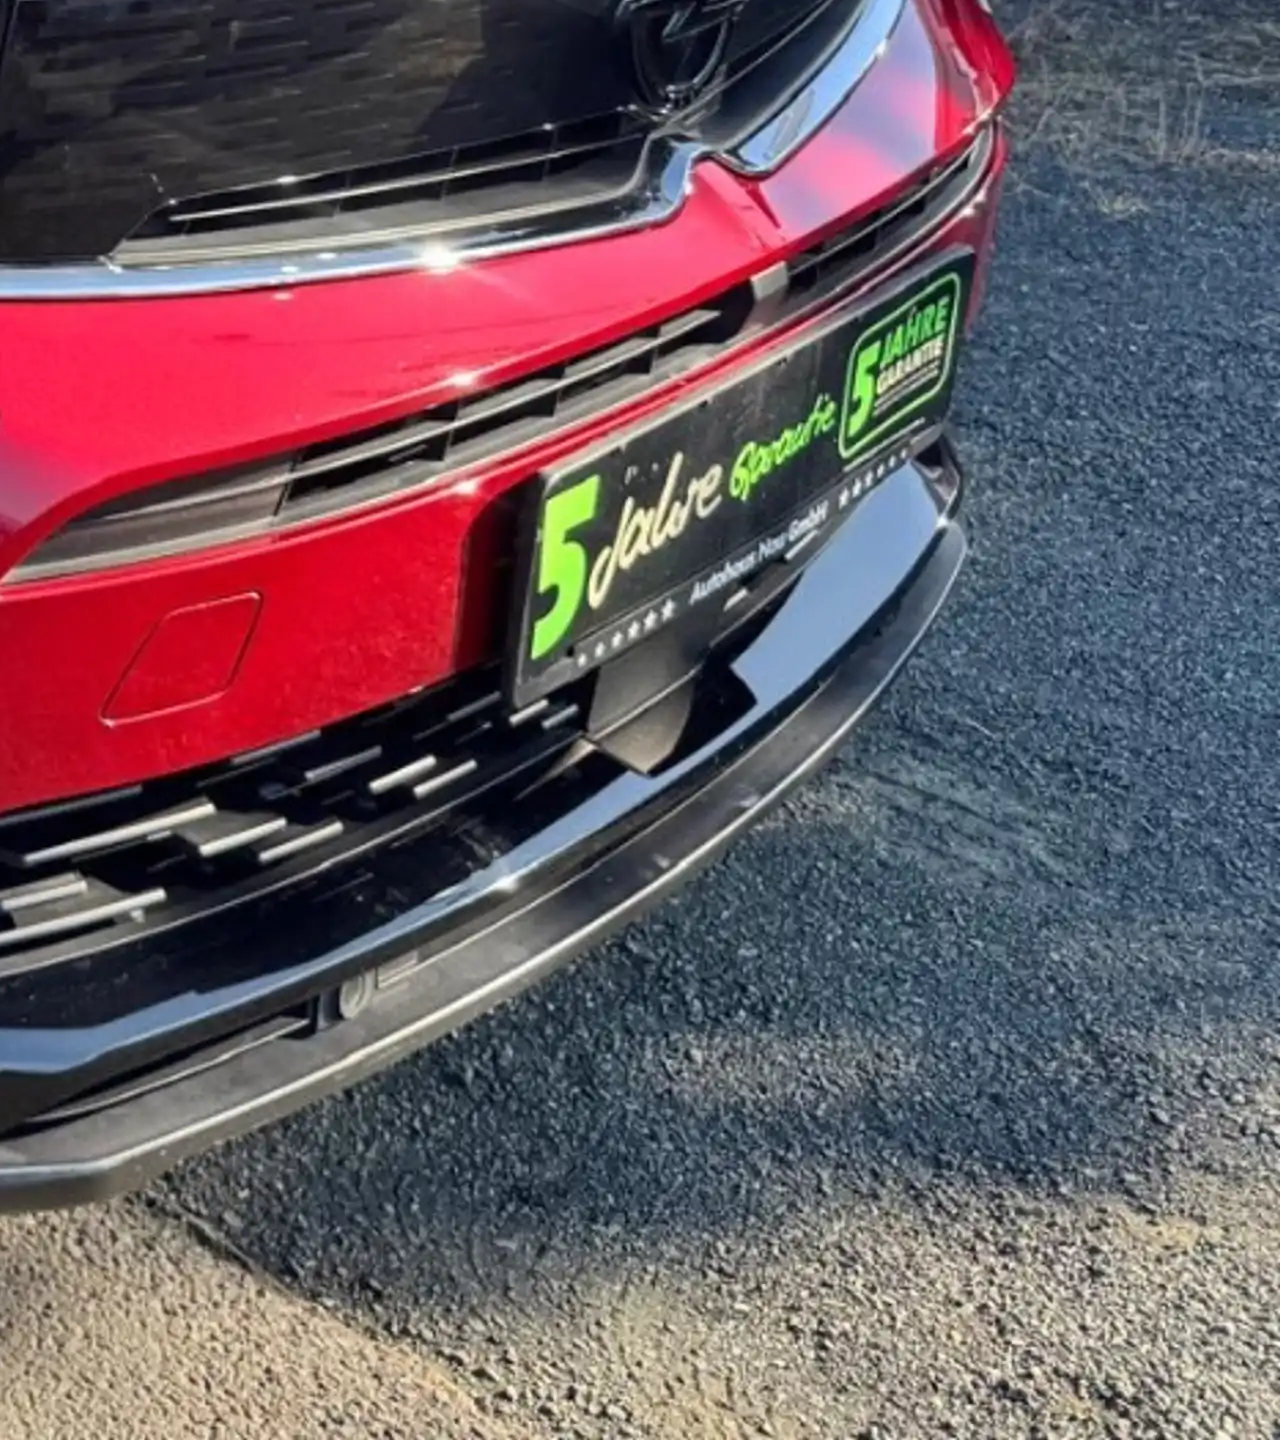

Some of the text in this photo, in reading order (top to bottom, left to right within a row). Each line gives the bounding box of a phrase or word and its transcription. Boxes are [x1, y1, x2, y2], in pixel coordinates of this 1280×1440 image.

[848, 340, 882, 437] 5
[880, 295, 950, 369] JAHRE
[531, 474, 600, 659] 5
[588, 452, 723, 609] Jahre
